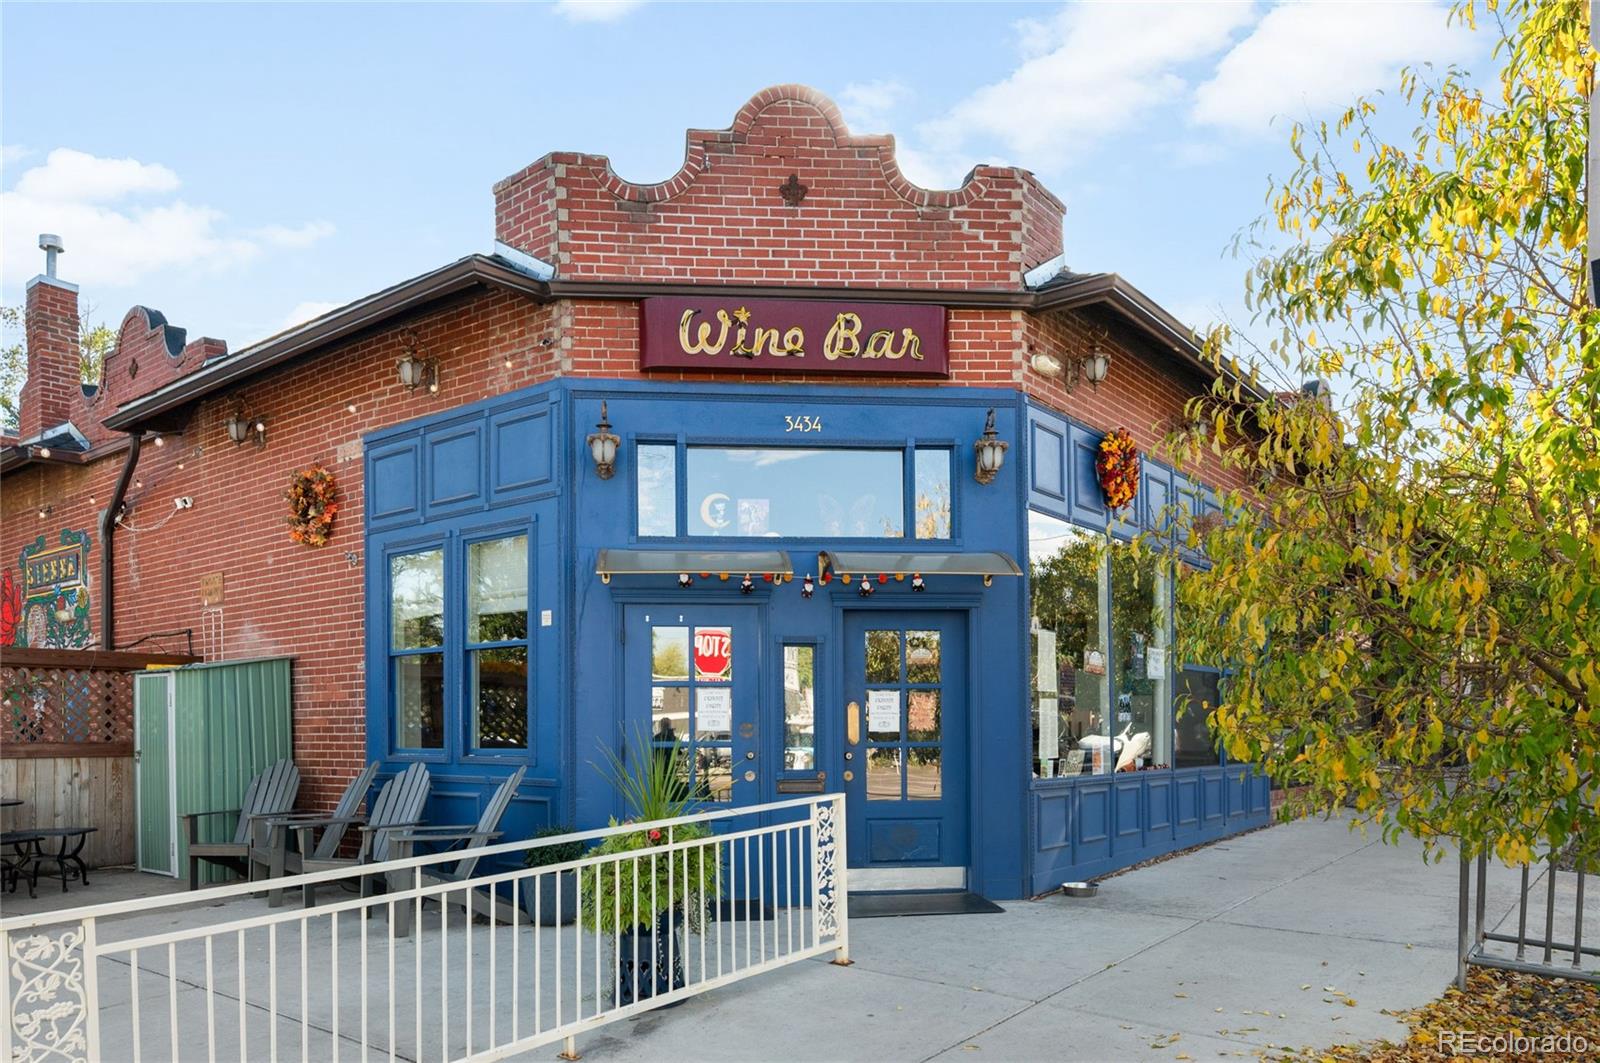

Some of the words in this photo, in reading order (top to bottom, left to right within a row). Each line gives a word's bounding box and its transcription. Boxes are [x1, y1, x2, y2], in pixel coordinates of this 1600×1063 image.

[679, 306, 804, 359] Wine
[823, 311, 924, 361] Bar
[784, 415, 822, 433] 3434
